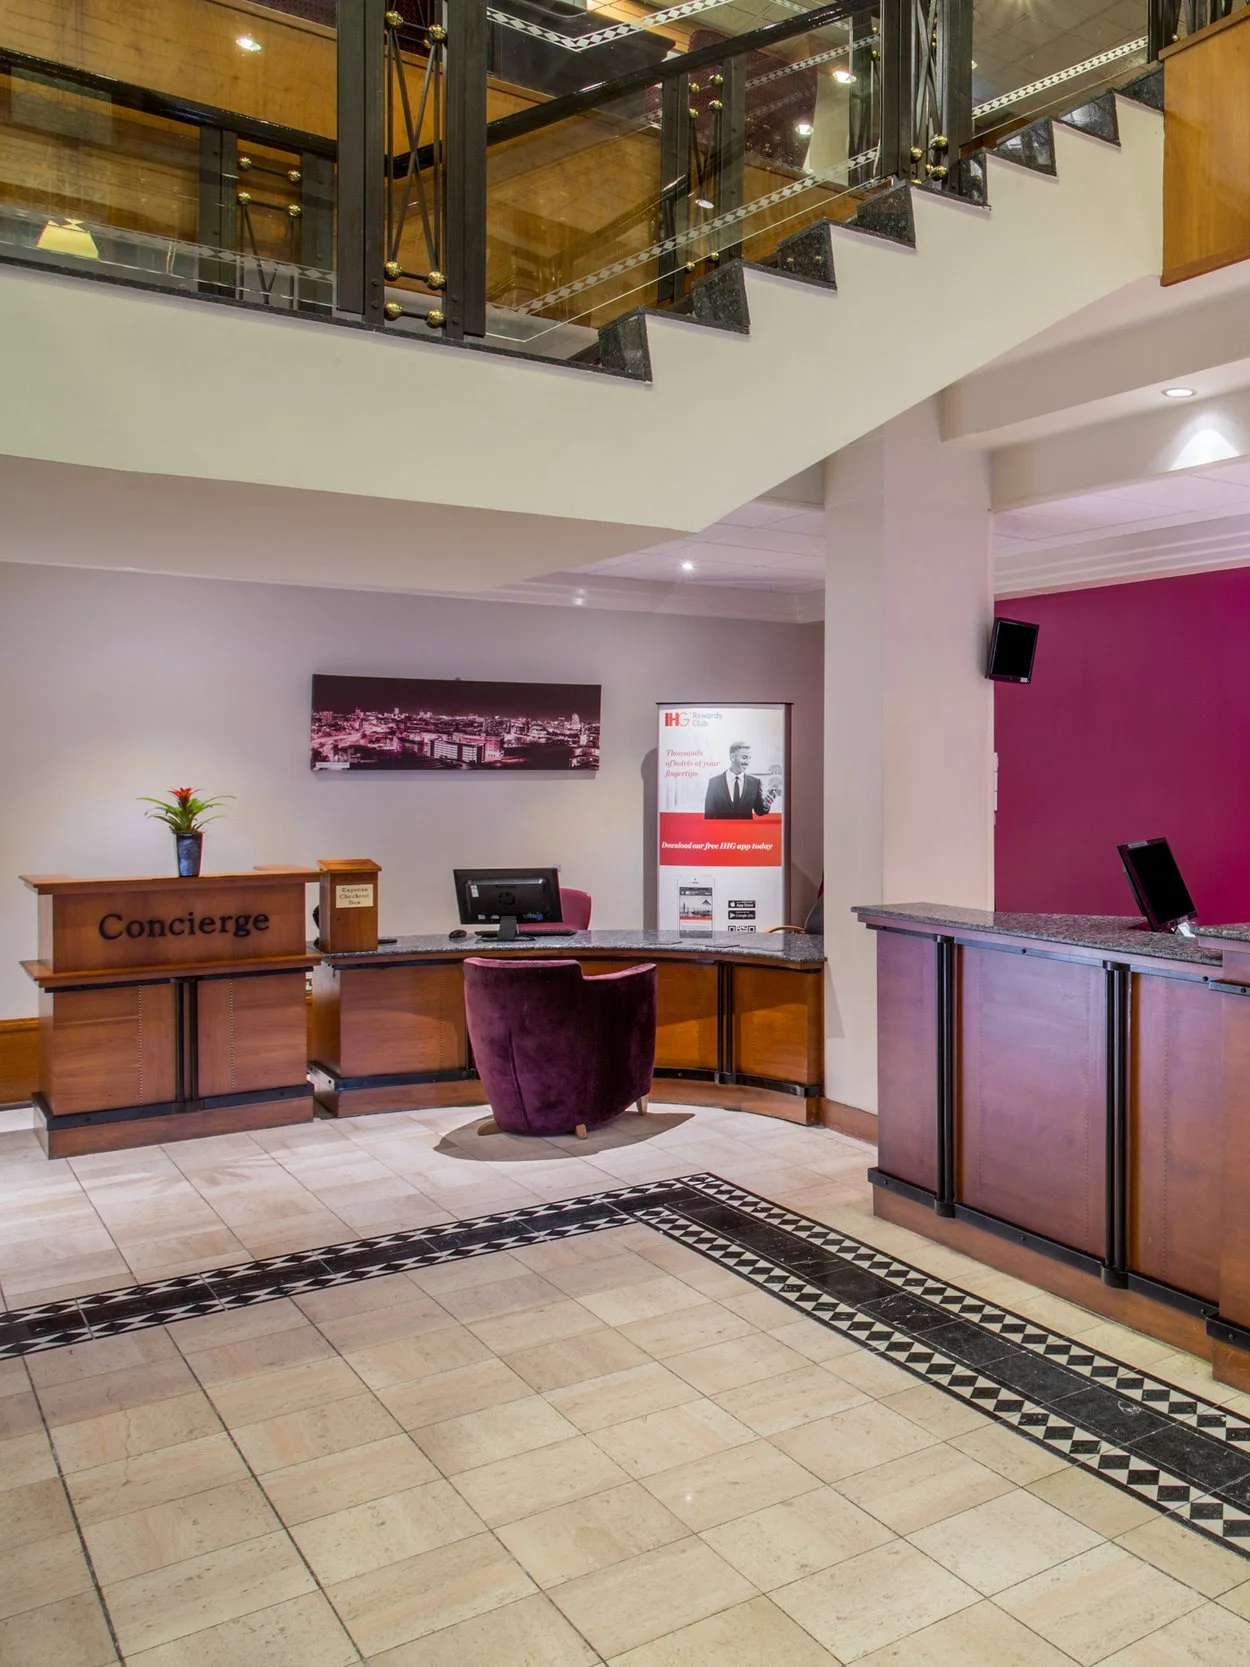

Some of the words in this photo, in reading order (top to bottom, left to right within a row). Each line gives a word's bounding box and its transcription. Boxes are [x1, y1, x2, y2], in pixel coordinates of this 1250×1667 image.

[665, 712, 690, 727] IHG
[666, 749, 703, 757] Thousands
[665, 759, 674, 768] of
[673, 759, 693, 767] hotels
[665, 770, 698, 778] fingertips
[661, 841, 692, 849] Download
[704, 841, 719, 851] free
[719, 841, 736, 849] IHG
[736, 843, 751, 851] app
[98, 911, 270, 941] Concierge
